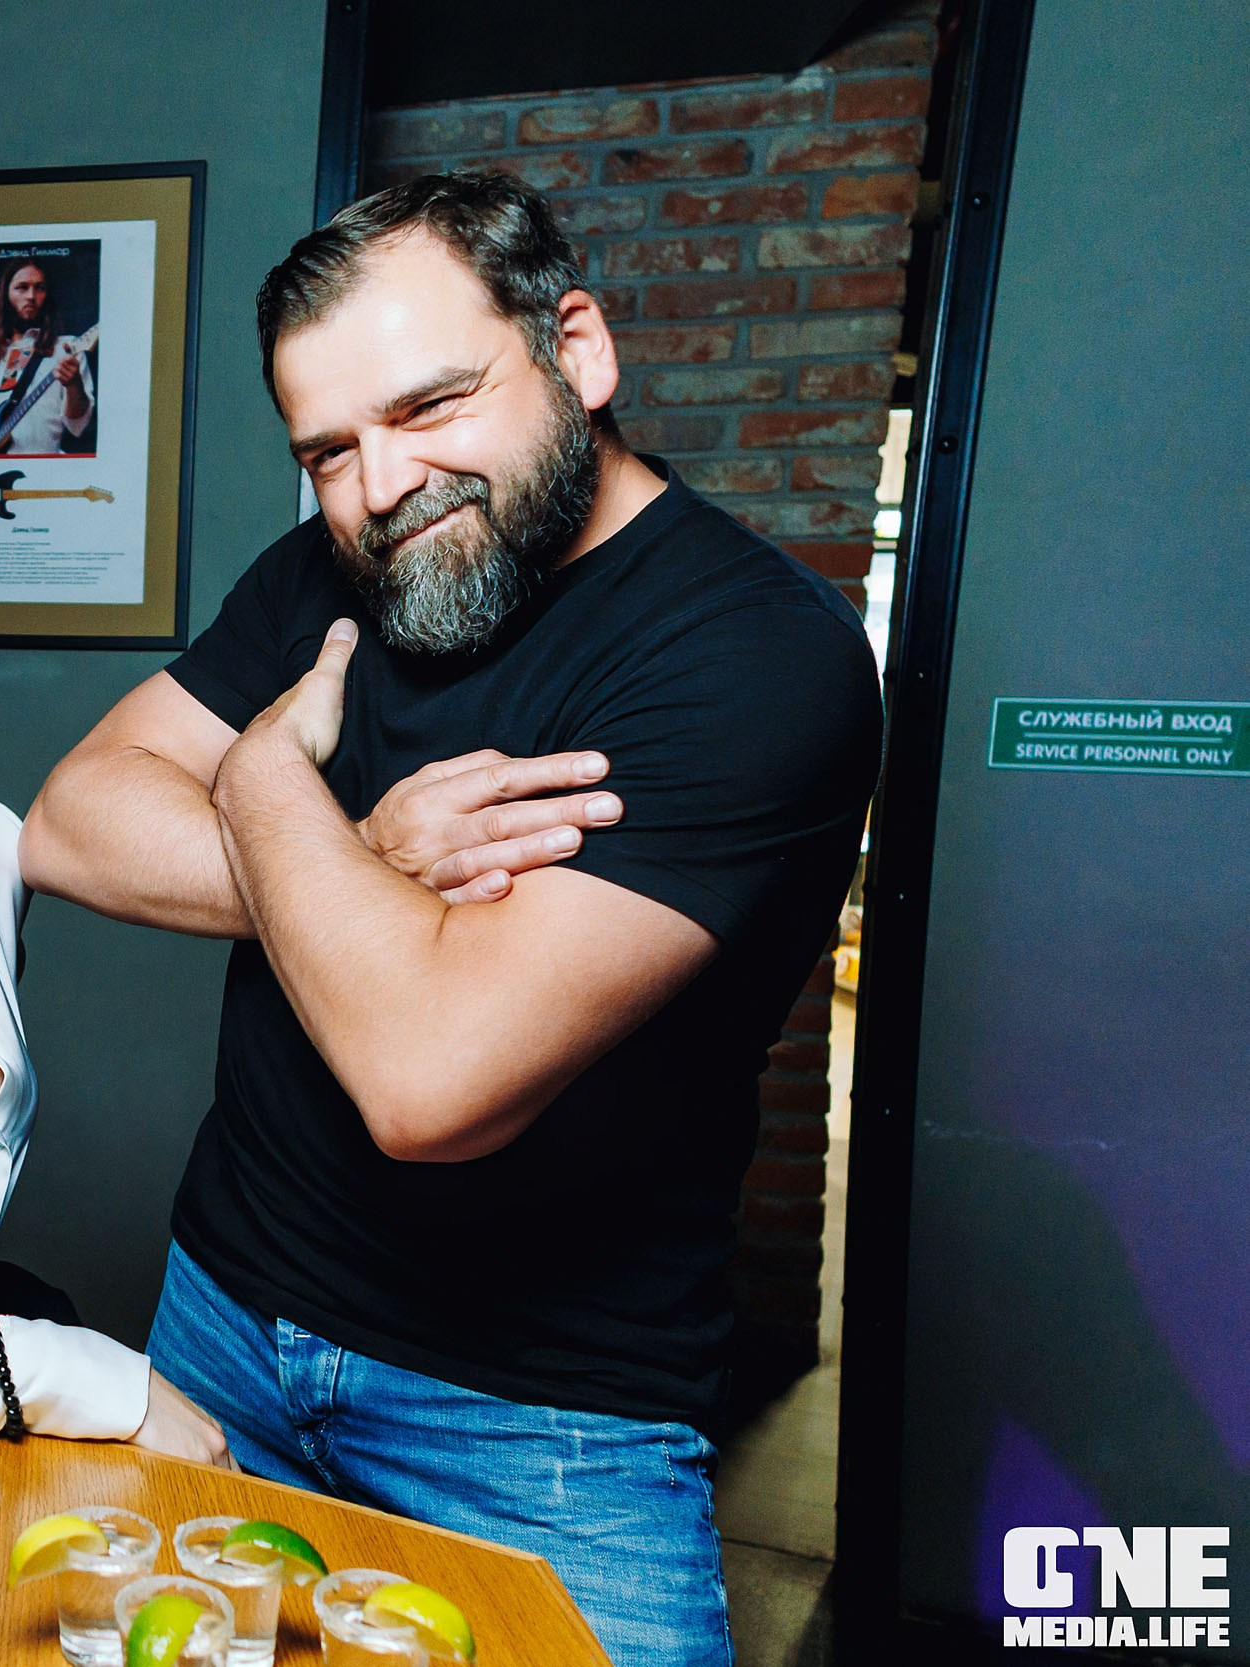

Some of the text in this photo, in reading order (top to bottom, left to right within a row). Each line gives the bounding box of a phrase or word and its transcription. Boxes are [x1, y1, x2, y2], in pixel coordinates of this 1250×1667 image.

[1018, 709, 1232, 733] СЛУЖЕБНЫЙ ВХОД
[1016, 743, 1233, 765] SERVICE PERSONNEL ONLY
